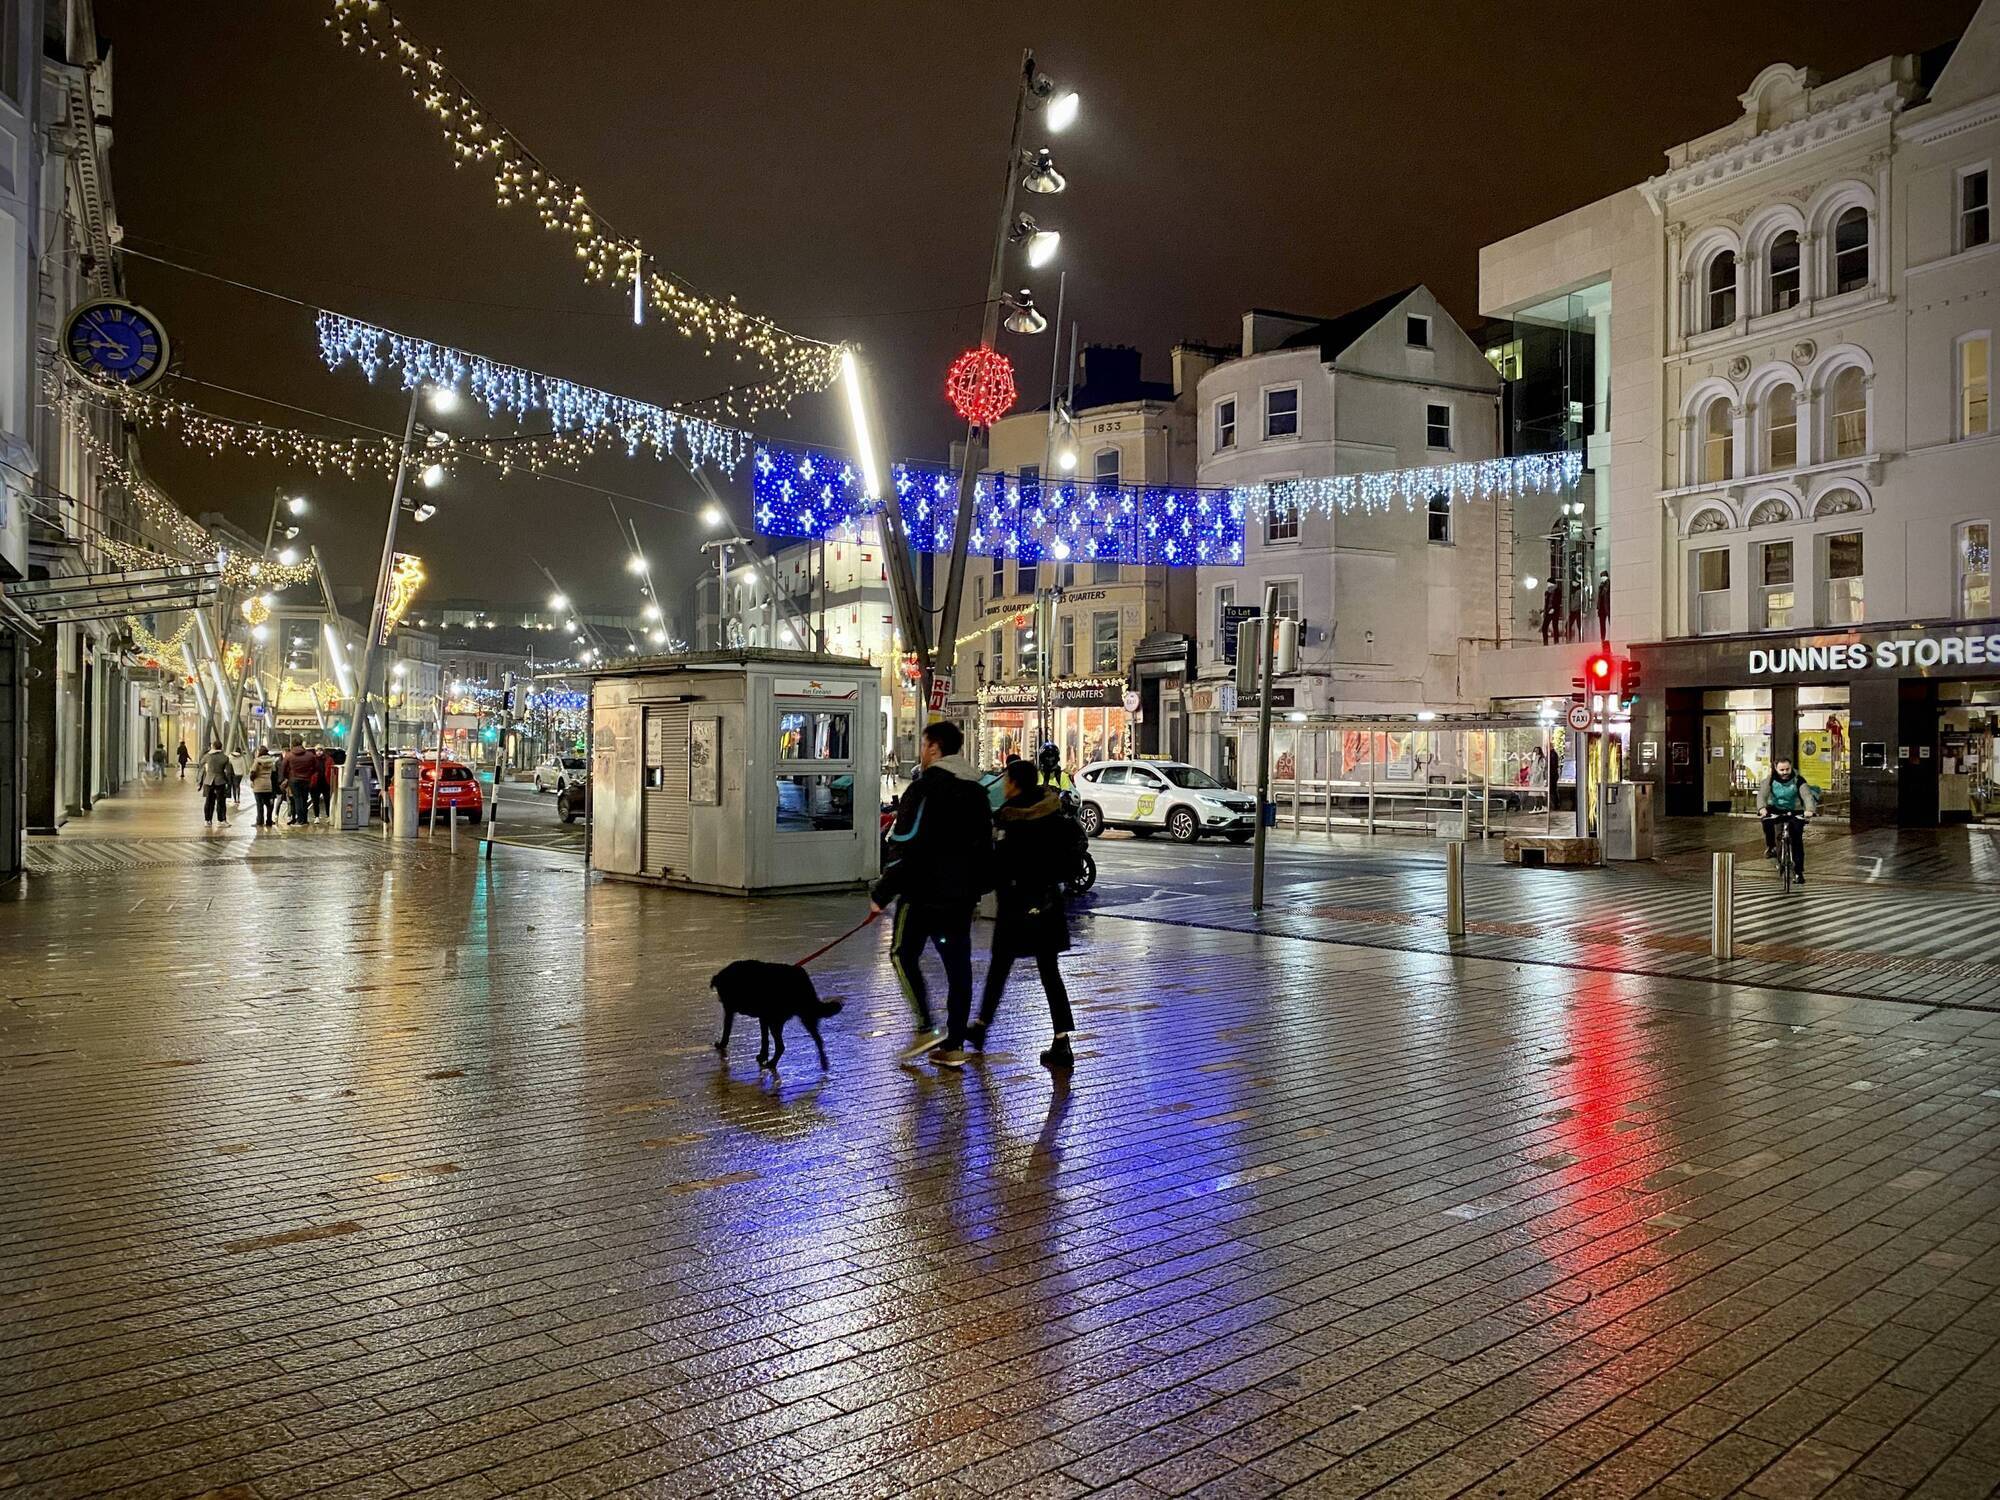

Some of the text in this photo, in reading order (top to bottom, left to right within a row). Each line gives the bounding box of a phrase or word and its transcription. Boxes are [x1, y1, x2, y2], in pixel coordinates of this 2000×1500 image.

[1093, 421, 1121, 433] 1833
[1069, 591, 1106, 602] QUARTERS
[1226, 608, 1251, 616] To Let
[1749, 634, 2000, 674] DUNNES STORES
[999, 694, 1038, 703] QUARTERS
[1067, 689, 1104, 700] QUARTERS
